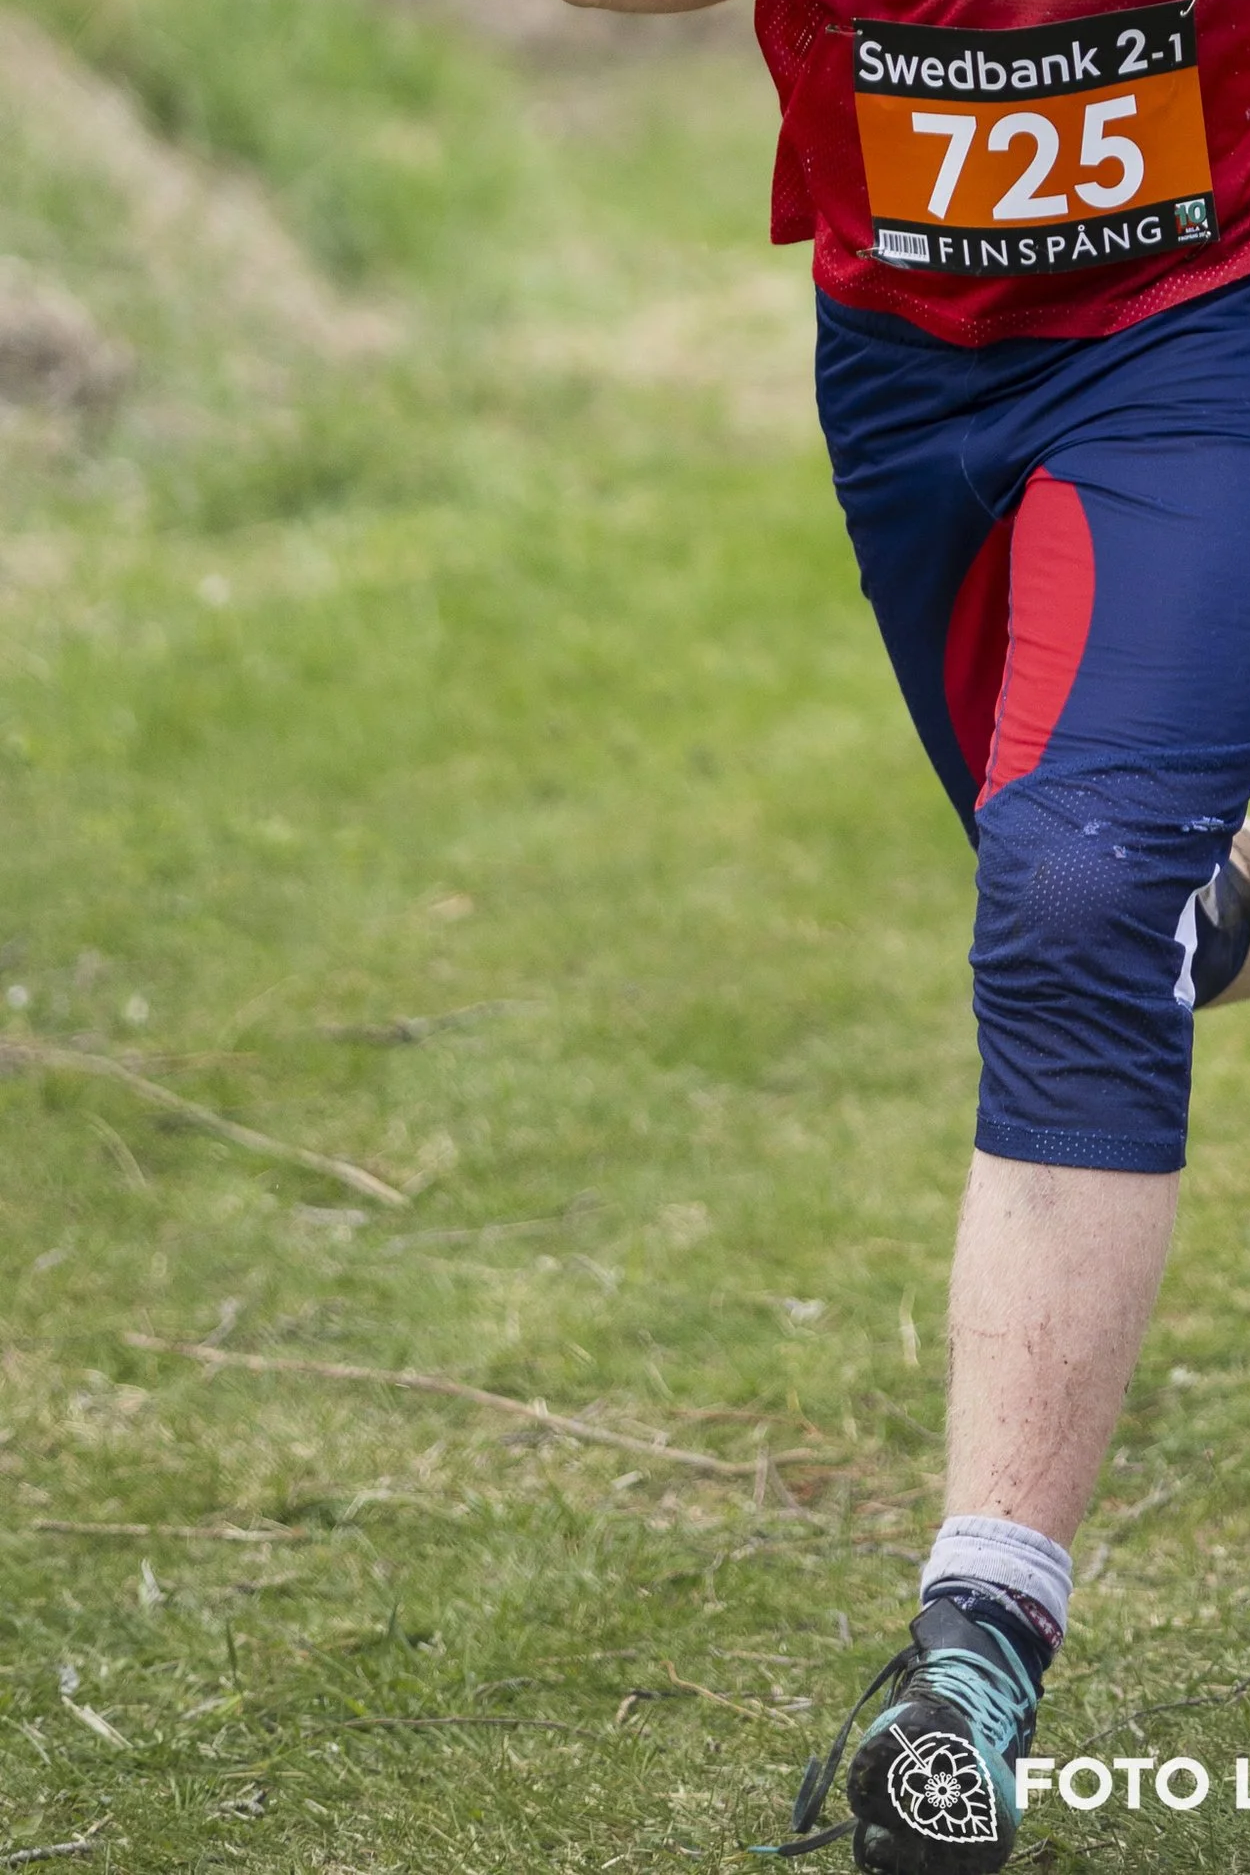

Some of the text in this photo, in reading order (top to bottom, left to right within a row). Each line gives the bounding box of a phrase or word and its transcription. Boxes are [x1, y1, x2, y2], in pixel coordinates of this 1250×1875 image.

[859, 29, 1183, 92] Swedbank 2-1
[911, 94, 1145, 221] 725
[938, 216, 1163, 267] FINSPÅNG
